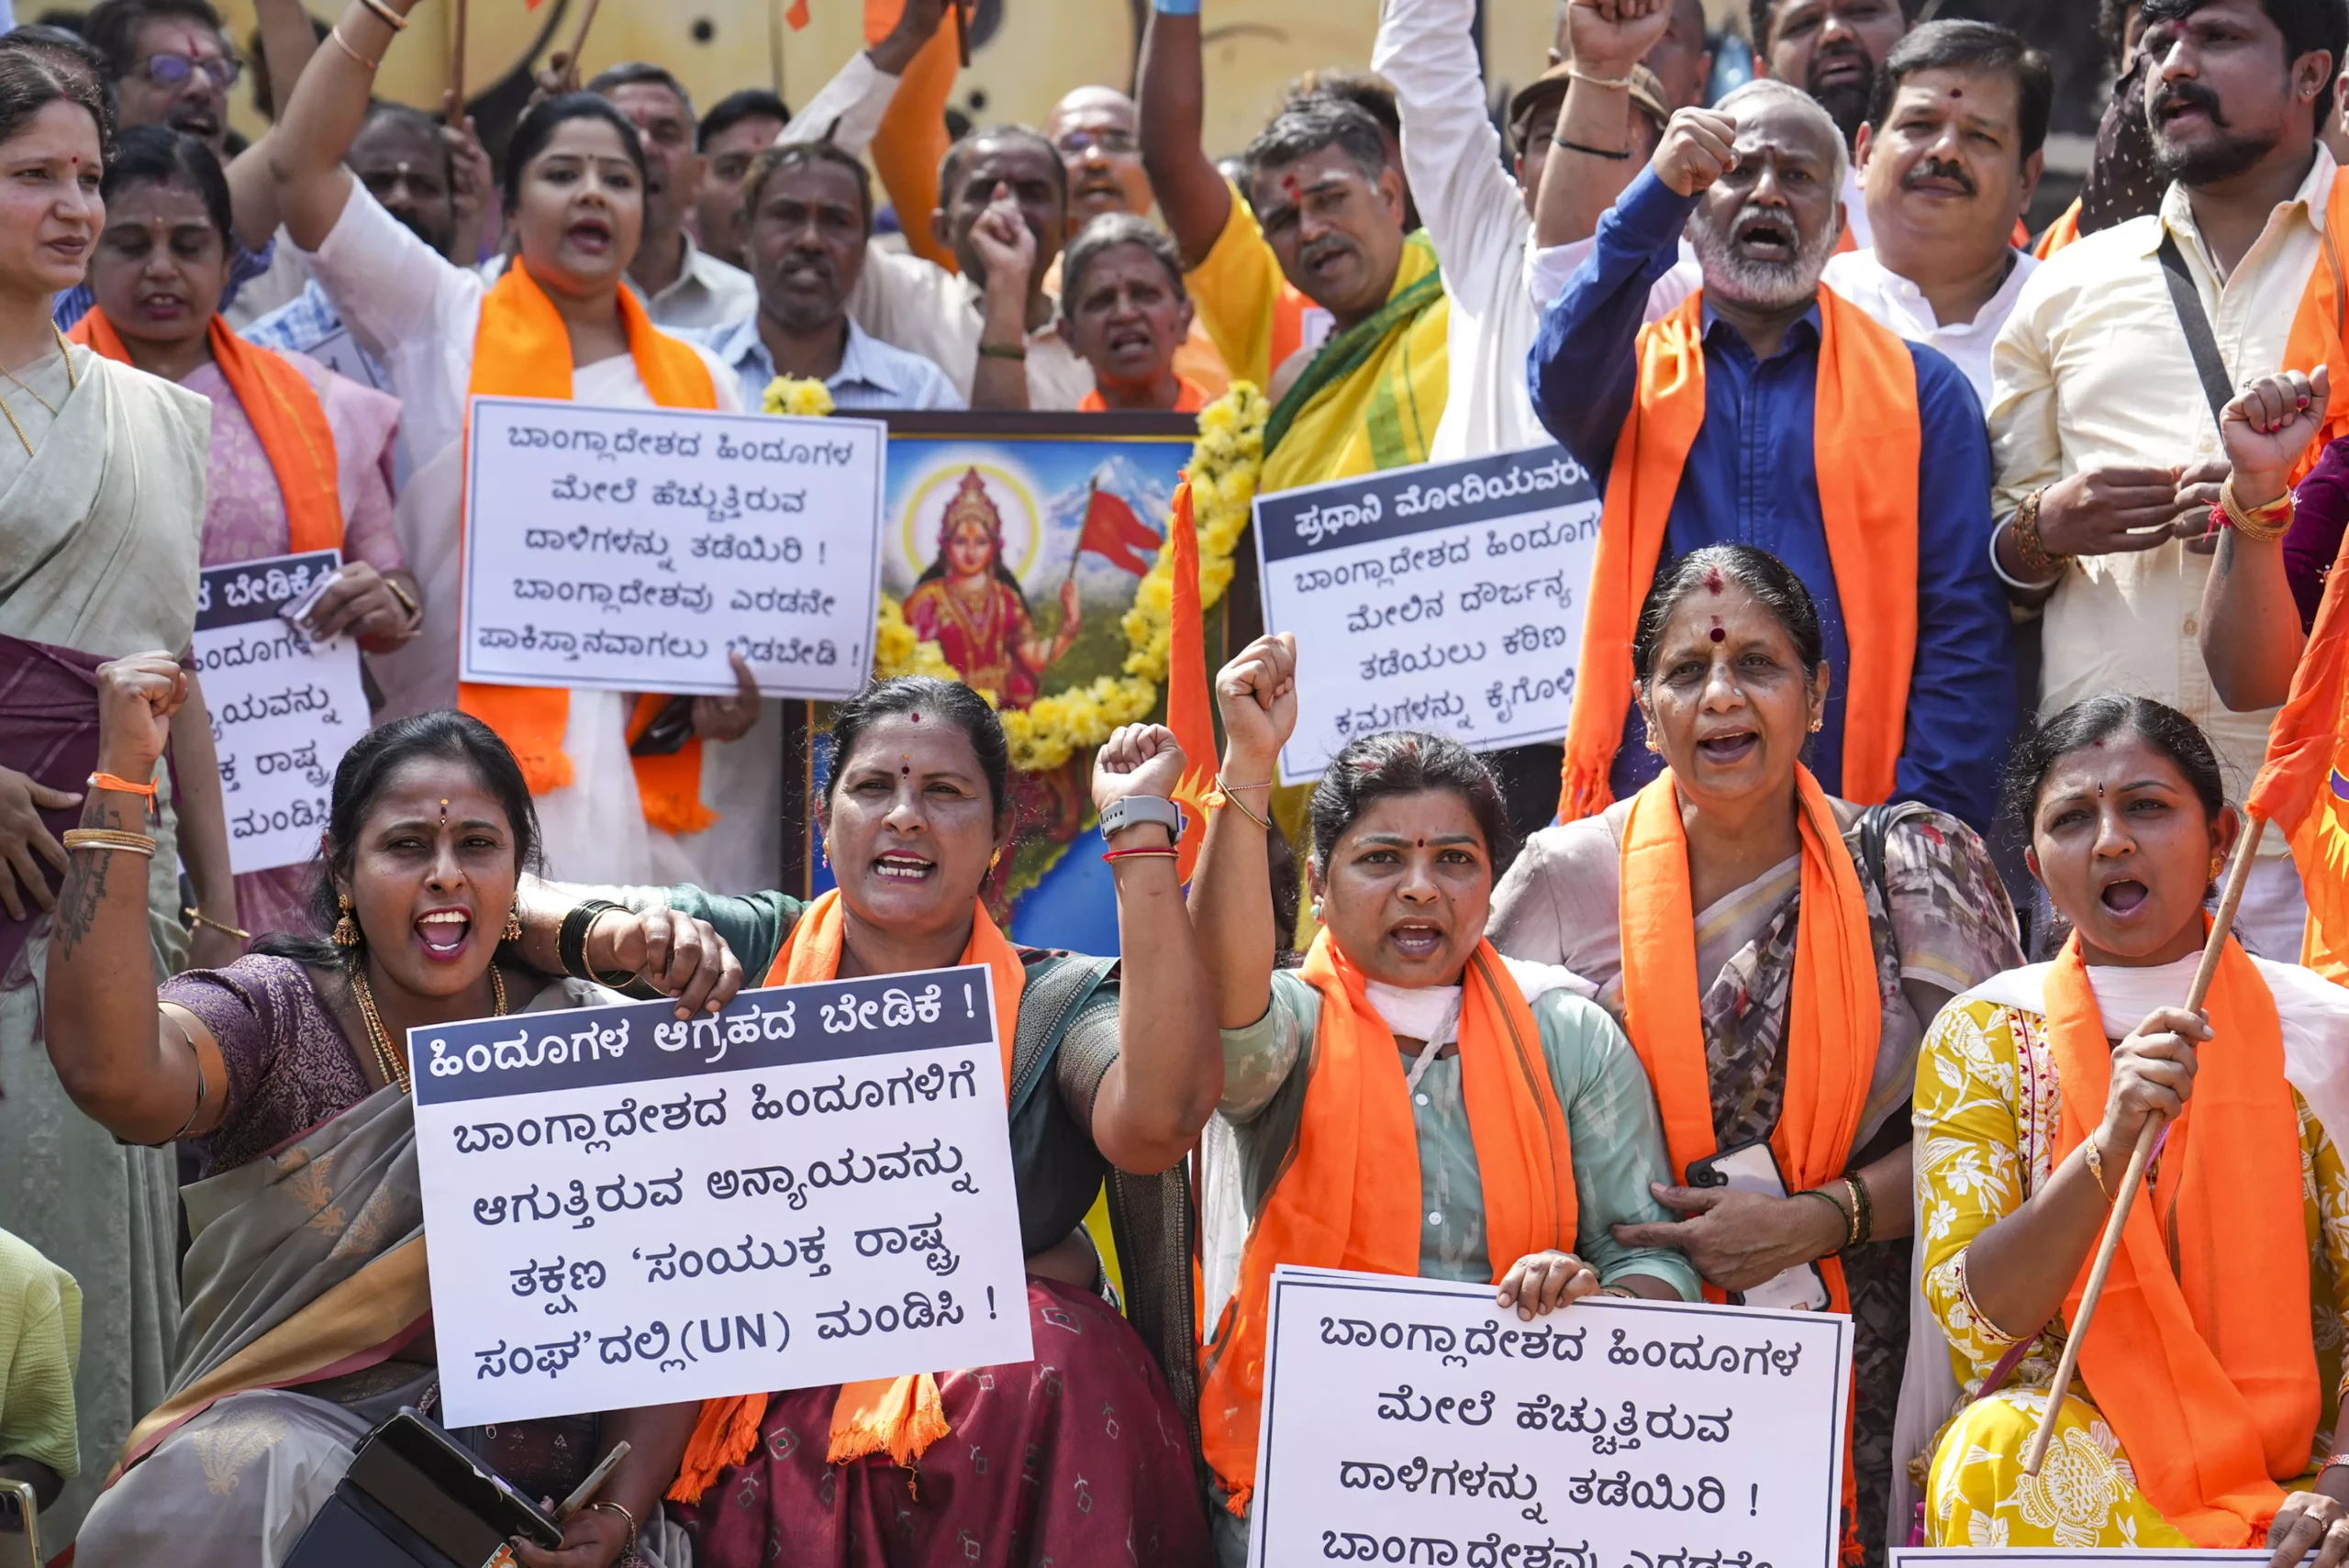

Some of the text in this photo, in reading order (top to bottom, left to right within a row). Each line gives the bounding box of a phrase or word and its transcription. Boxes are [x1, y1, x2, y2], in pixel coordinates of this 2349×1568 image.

[507, 426, 854, 466] ಬಾಂಗ್ಲಾದೇಶದ ಹಿಂದೂಗಳ
[551, 473, 807, 523] ಮೇಲೆ ಹೆಚ್ಚುತ್ತಿರುವ
[1295, 495, 1383, 545] ಪ್ರಧಾನಿ
[525, 524, 826, 573] ದಾಳಿಗಳನ್ನು ತಡೆಯಿರಿ !
[1295, 511, 1602, 593] ಬಾಂಗ್ಲಾದೇಶದ ಹಿಂದೂಗ
[512, 579, 837, 617] ಬಾಂಗ್ಲಾದೇಶವು ಎರಡನೇ
[1347, 569, 1572, 634] ಮೇಲಿನ ದೌರ್ಜನ್ಯ
[478, 623, 708, 662] ಪಾಕಿಸ್ತಾನವಾಗಲು
[851, 644, 861, 668] !
[1360, 624, 1566, 681] ತಡೆಯಲು ಕಠಿಣ
[430, 984, 974, 1076] ಹಿಂದೂಗಳ ಆಗ್ರಹದ ಬೇಡಿಕೆ !
[453, 1061, 976, 1154] ಬಾಂಗ್ಲಾದೇಶದ ಹಿಂದೂಗಳಿಗೆ
[473, 1138, 979, 1229] ಆಗುತ್ತಿರುವ ಅನ್ಯಾಯವನ್ನು
[510, 1255, 606, 1315] ತಕ್ಷಣ
[854, 1212, 960, 1276] ರಾಷ್ಟ್ರ
[816, 1291, 964, 1340] ಮಂಡಿಸಿ
[987, 1285, 997, 1320] !
[1320, 1316, 1802, 1376] ಬಾಂಗ್ಲಾದೇಶದ ಹಿಂದೂಗಳ
[1378, 1385, 1732, 1455] ಮೇಲೆ ಹೆಚ್ಚುತ್ತಿರುವ
[1341, 1456, 1758, 1524] ದಾಳಿಗಳನ್ನು ತಡೆಯಿರಿ !
